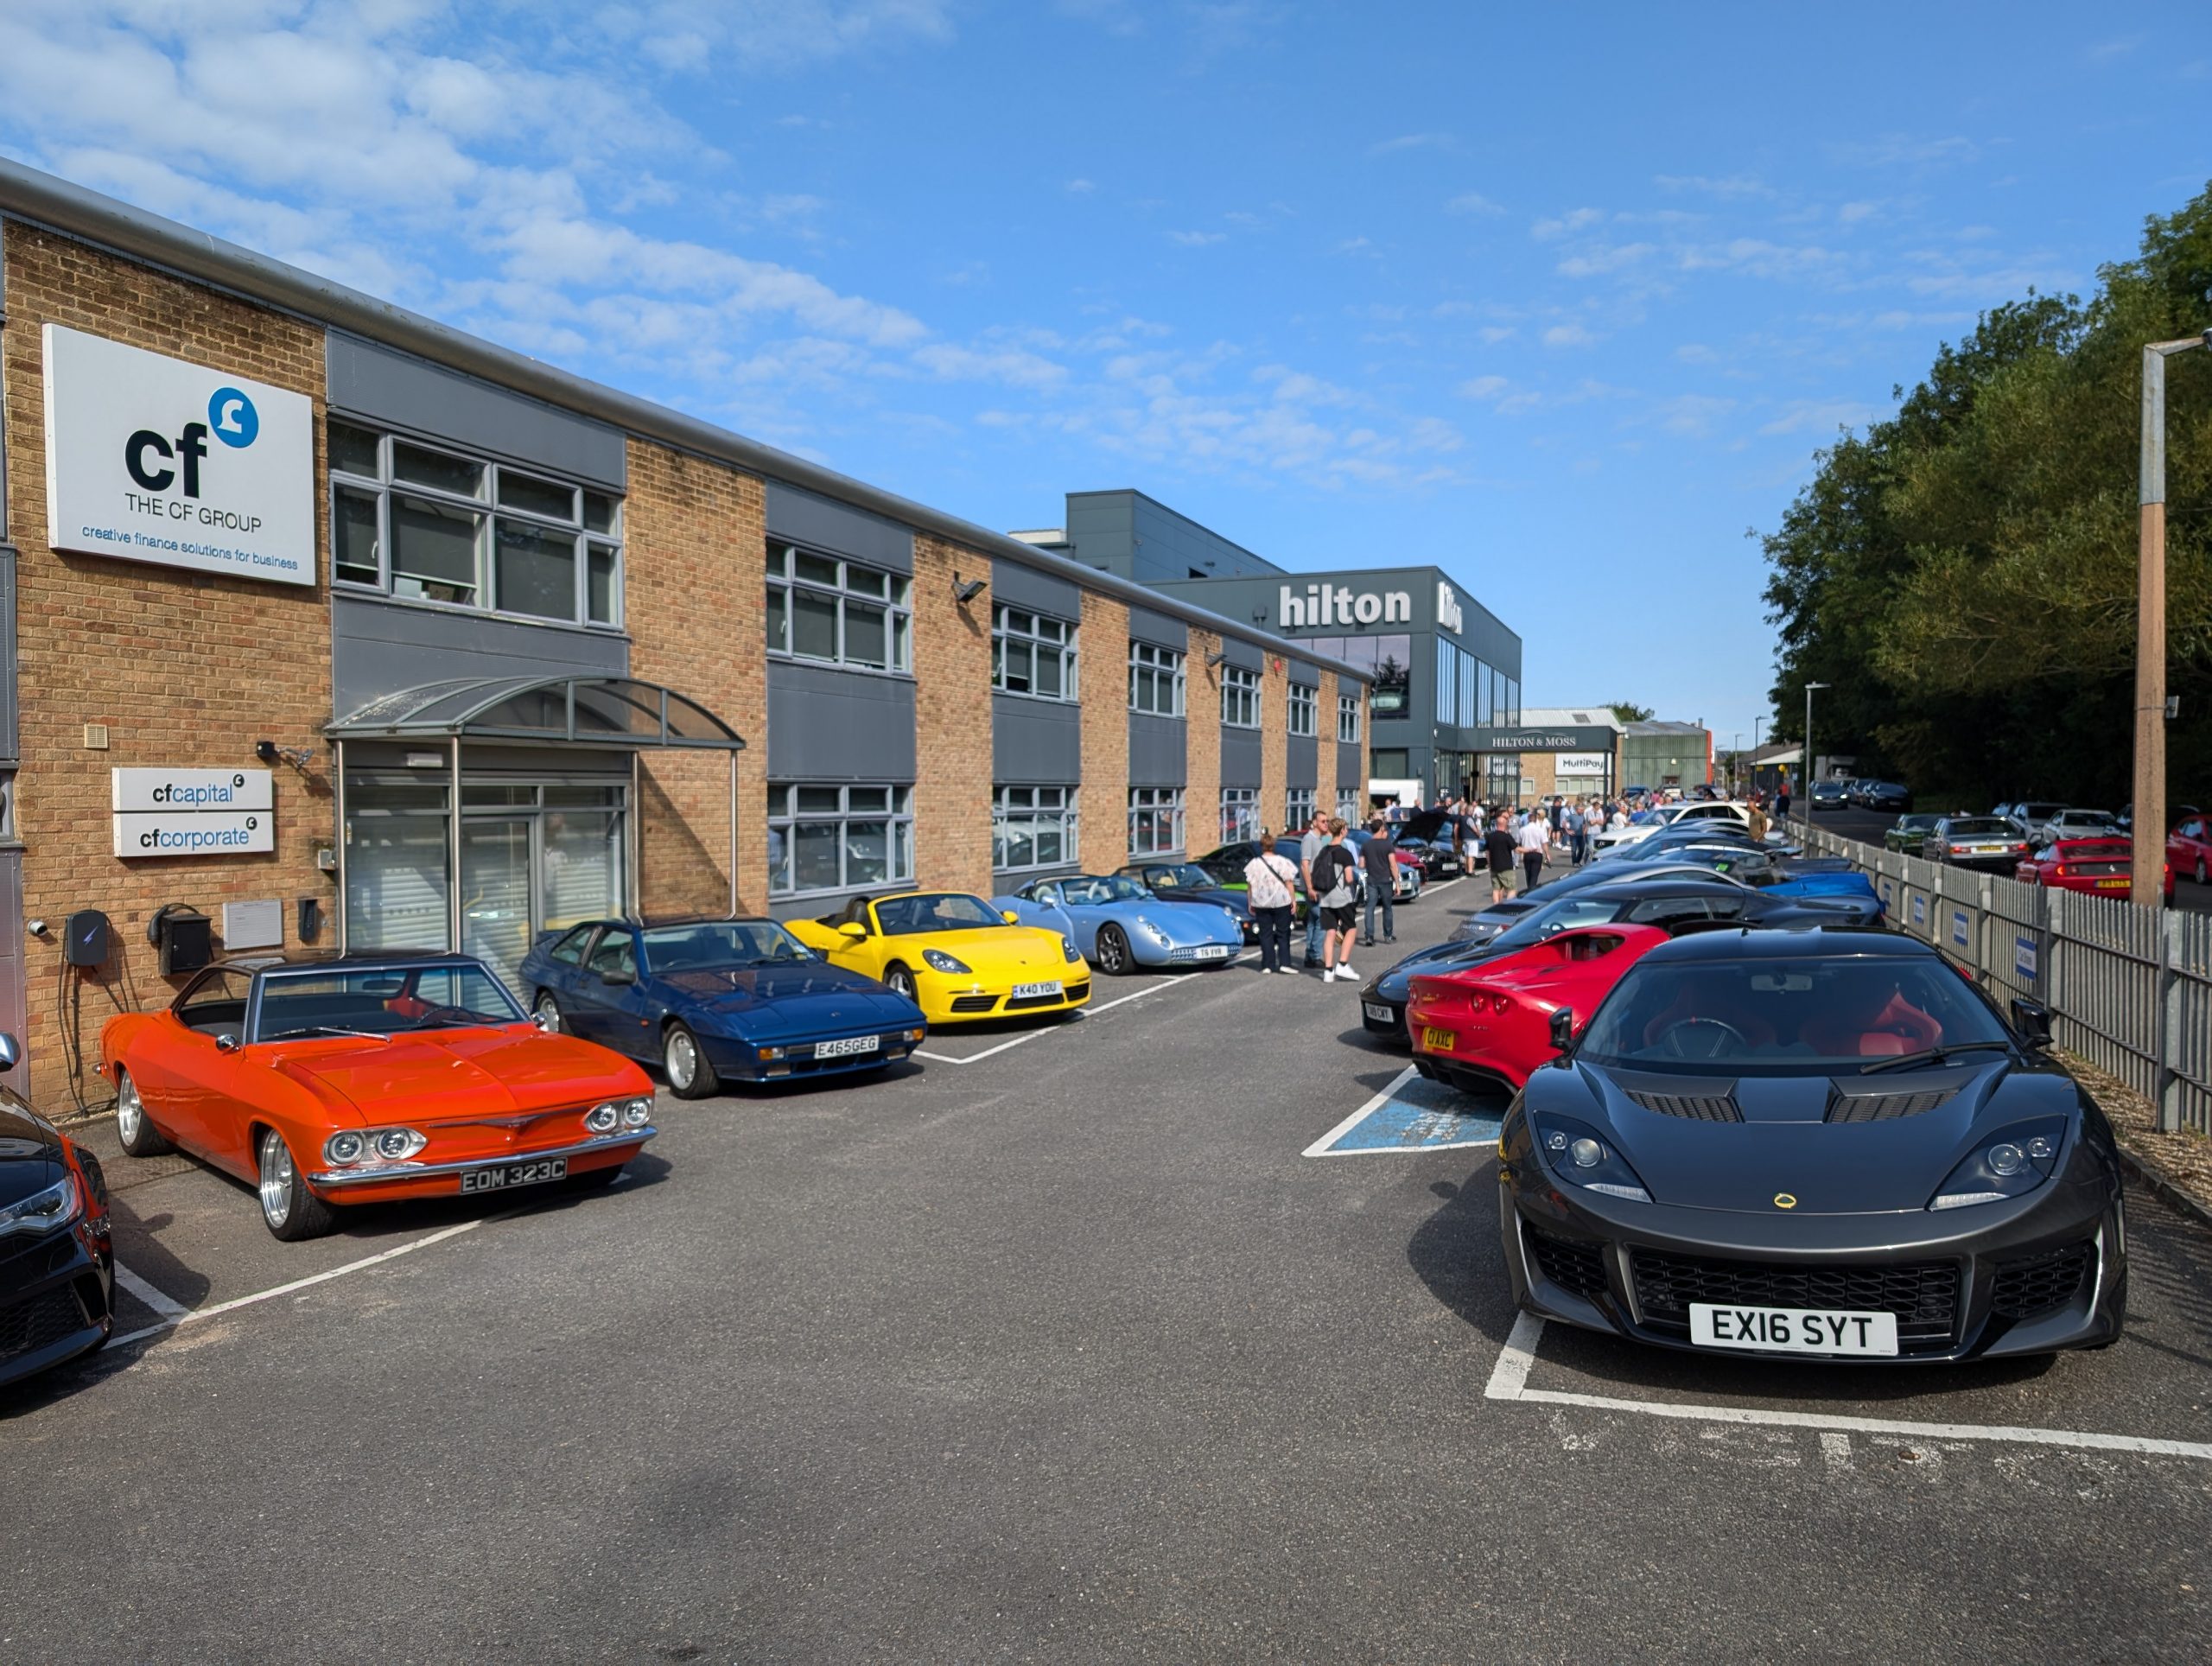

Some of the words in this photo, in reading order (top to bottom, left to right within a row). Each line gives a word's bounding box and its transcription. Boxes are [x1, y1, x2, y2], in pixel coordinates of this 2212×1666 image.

[124, 422, 207, 499] cf
[124, 493, 163, 517] THE
[168, 501, 194, 521] CF
[199, 507, 262, 534] GROUP
[82, 525, 131, 544] creative
[134, 533, 178, 551] finance
[181, 542, 232, 561] solutions
[234, 551, 250, 563] for
[252, 551, 298, 570] business
[1279, 584, 1411, 627] hilton
[1492, 737, 1535, 747] HILTON
[1536, 738, 1543, 747] &
[1545, 737, 1577, 747] MOSS
[1562, 758, 1604, 769] MultiPay
[1020, 984, 1039, 995] K40
[817, 1037, 876, 1056] E465GEG
[462, 1168, 505, 1192] EOM
[510, 1160, 565, 1185] 323C
[1802, 1314, 1872, 1348] SYT
